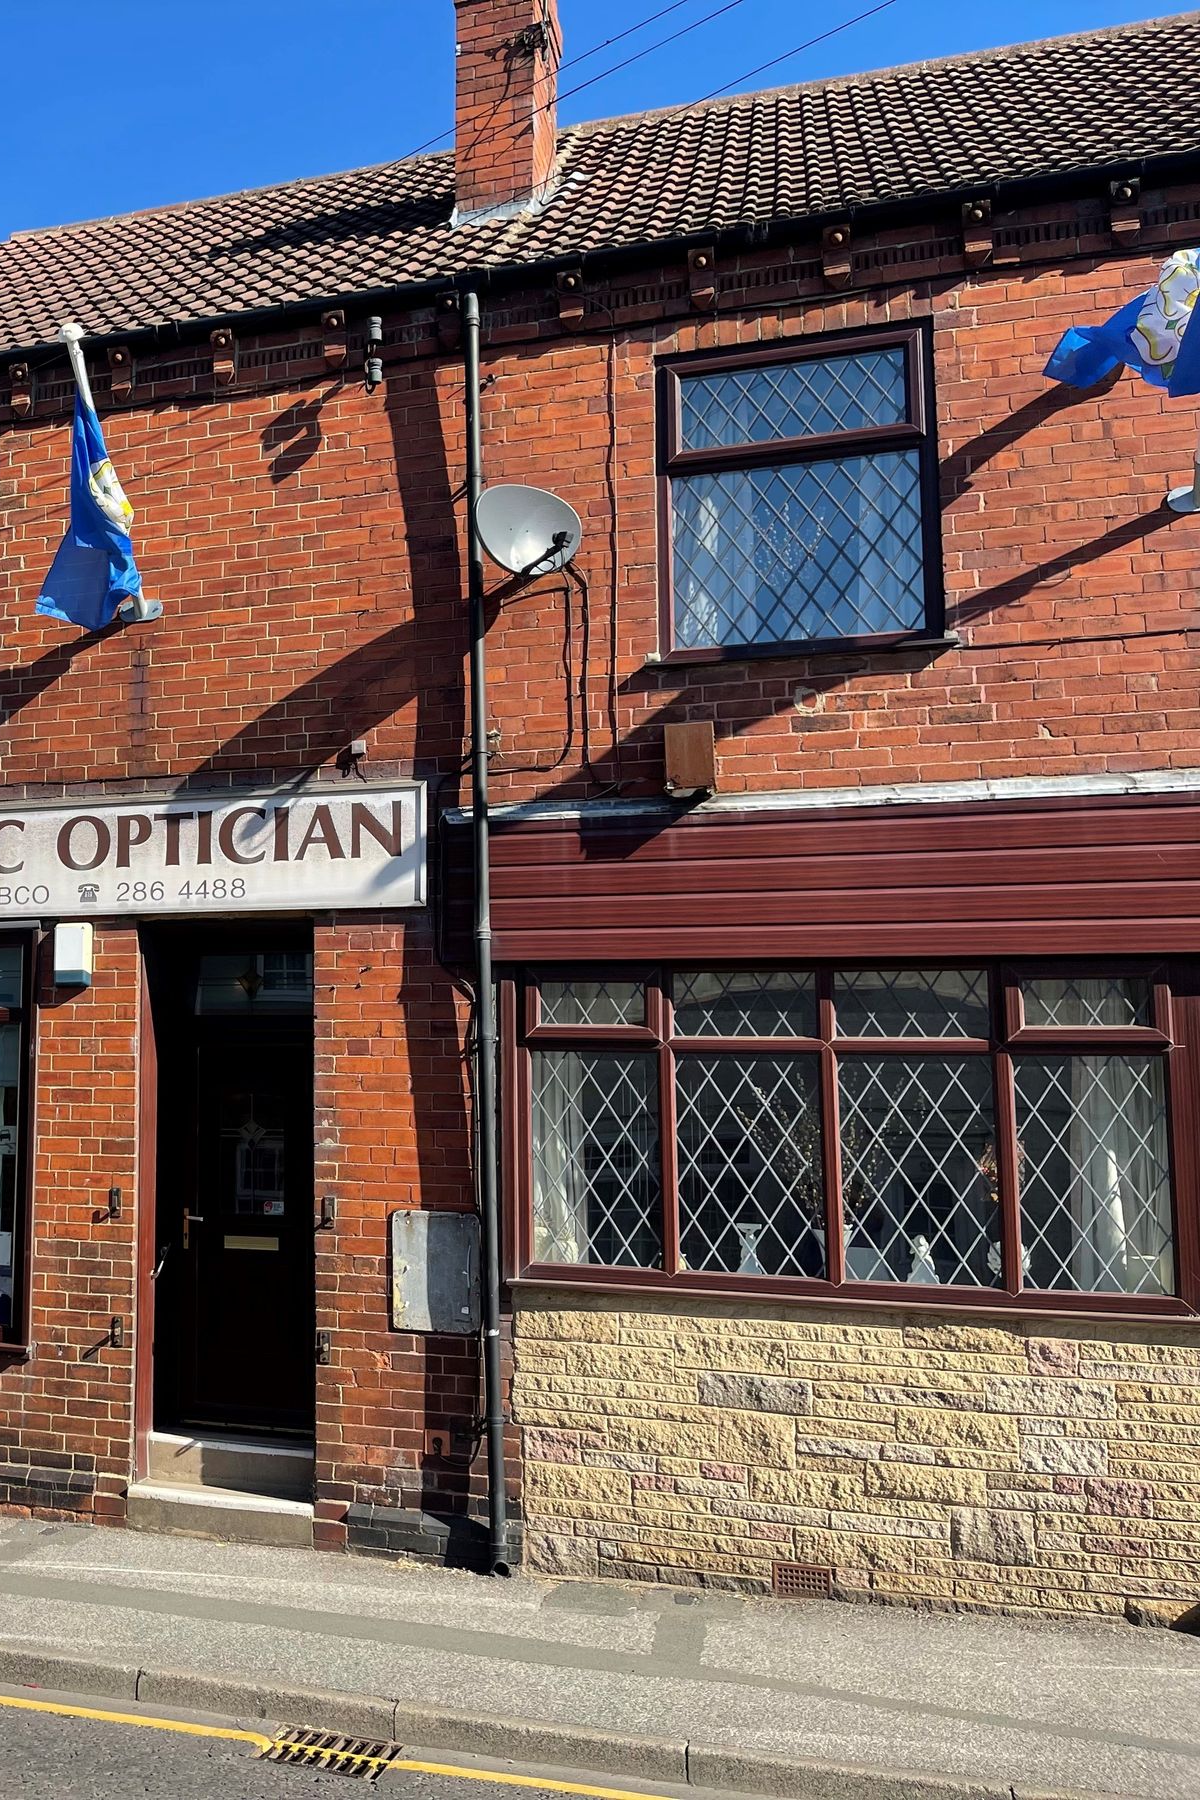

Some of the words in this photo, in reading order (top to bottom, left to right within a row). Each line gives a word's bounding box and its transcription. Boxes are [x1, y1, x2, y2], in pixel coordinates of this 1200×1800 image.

[56, 800, 403, 871] OPTICIAN
[116, 881, 165, 902] 286
[178, 878, 247, 900] 4488
